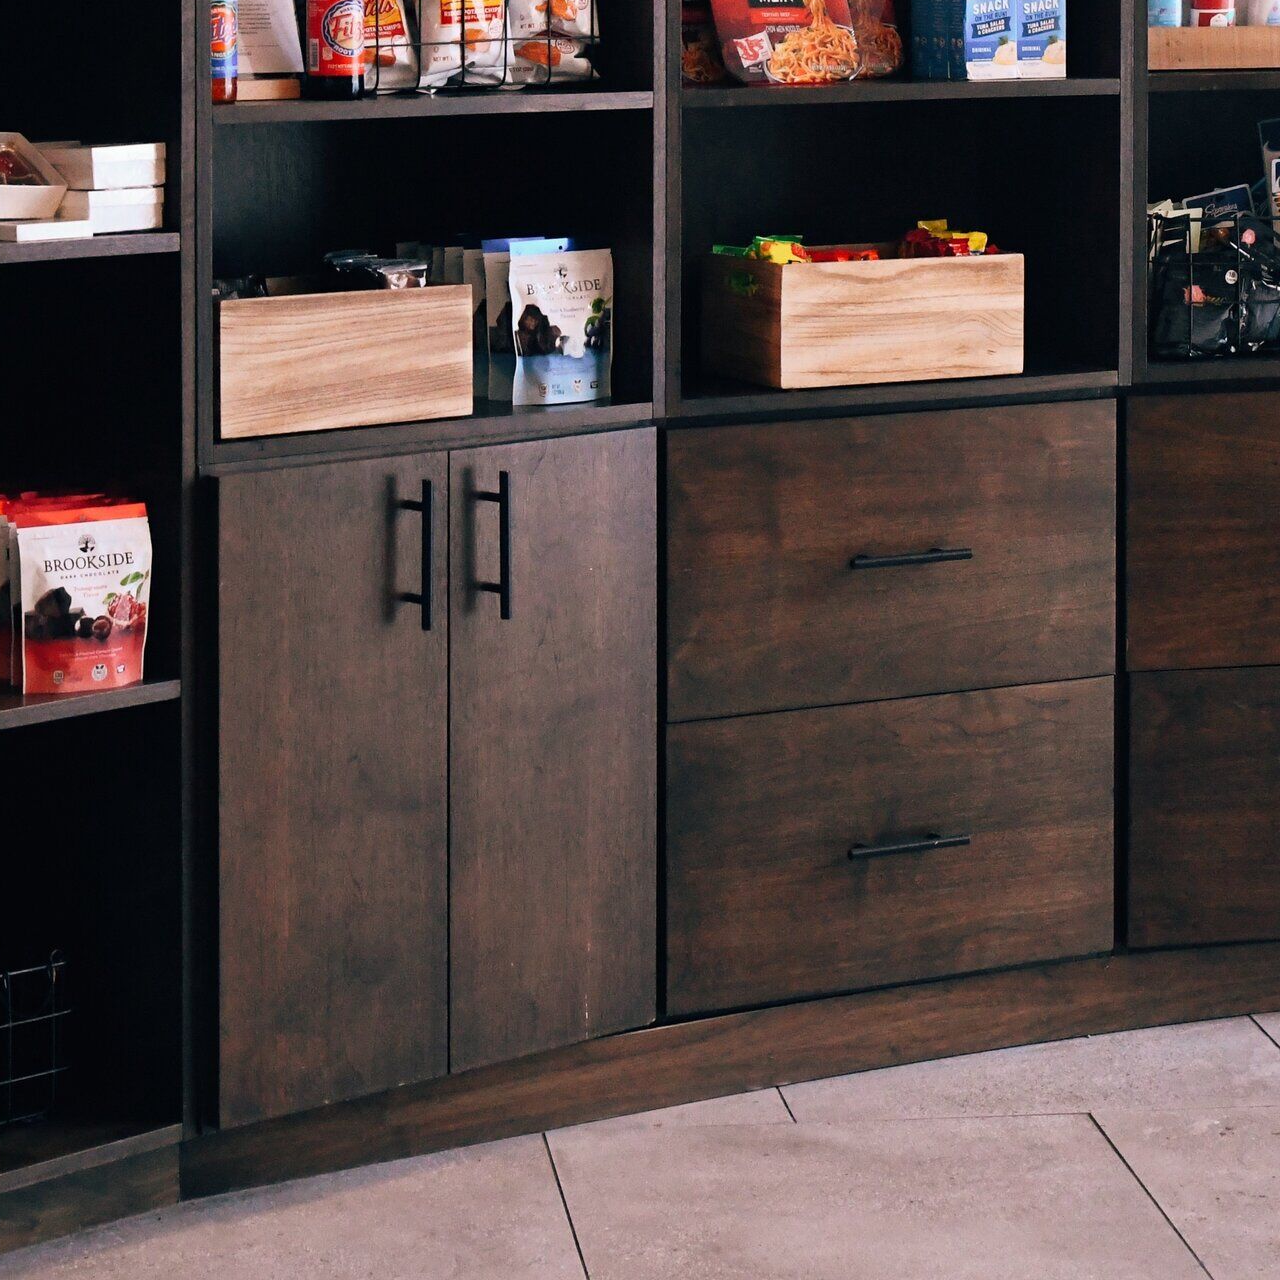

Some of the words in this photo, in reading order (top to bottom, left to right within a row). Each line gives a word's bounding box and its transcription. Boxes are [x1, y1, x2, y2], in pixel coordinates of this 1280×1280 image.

[989, 20, 1005, 28] SALAD
[1040, 18, 1055, 27] SALAD
[981, 25, 1006, 34] CRACKERS
[1031, 24, 1055, 33] CRACKERS
[335, 45, 352, 56] ROOT
[44, 551, 134, 573] BROOKSIDE
[79, 570, 120, 578] CHOCOLATE
